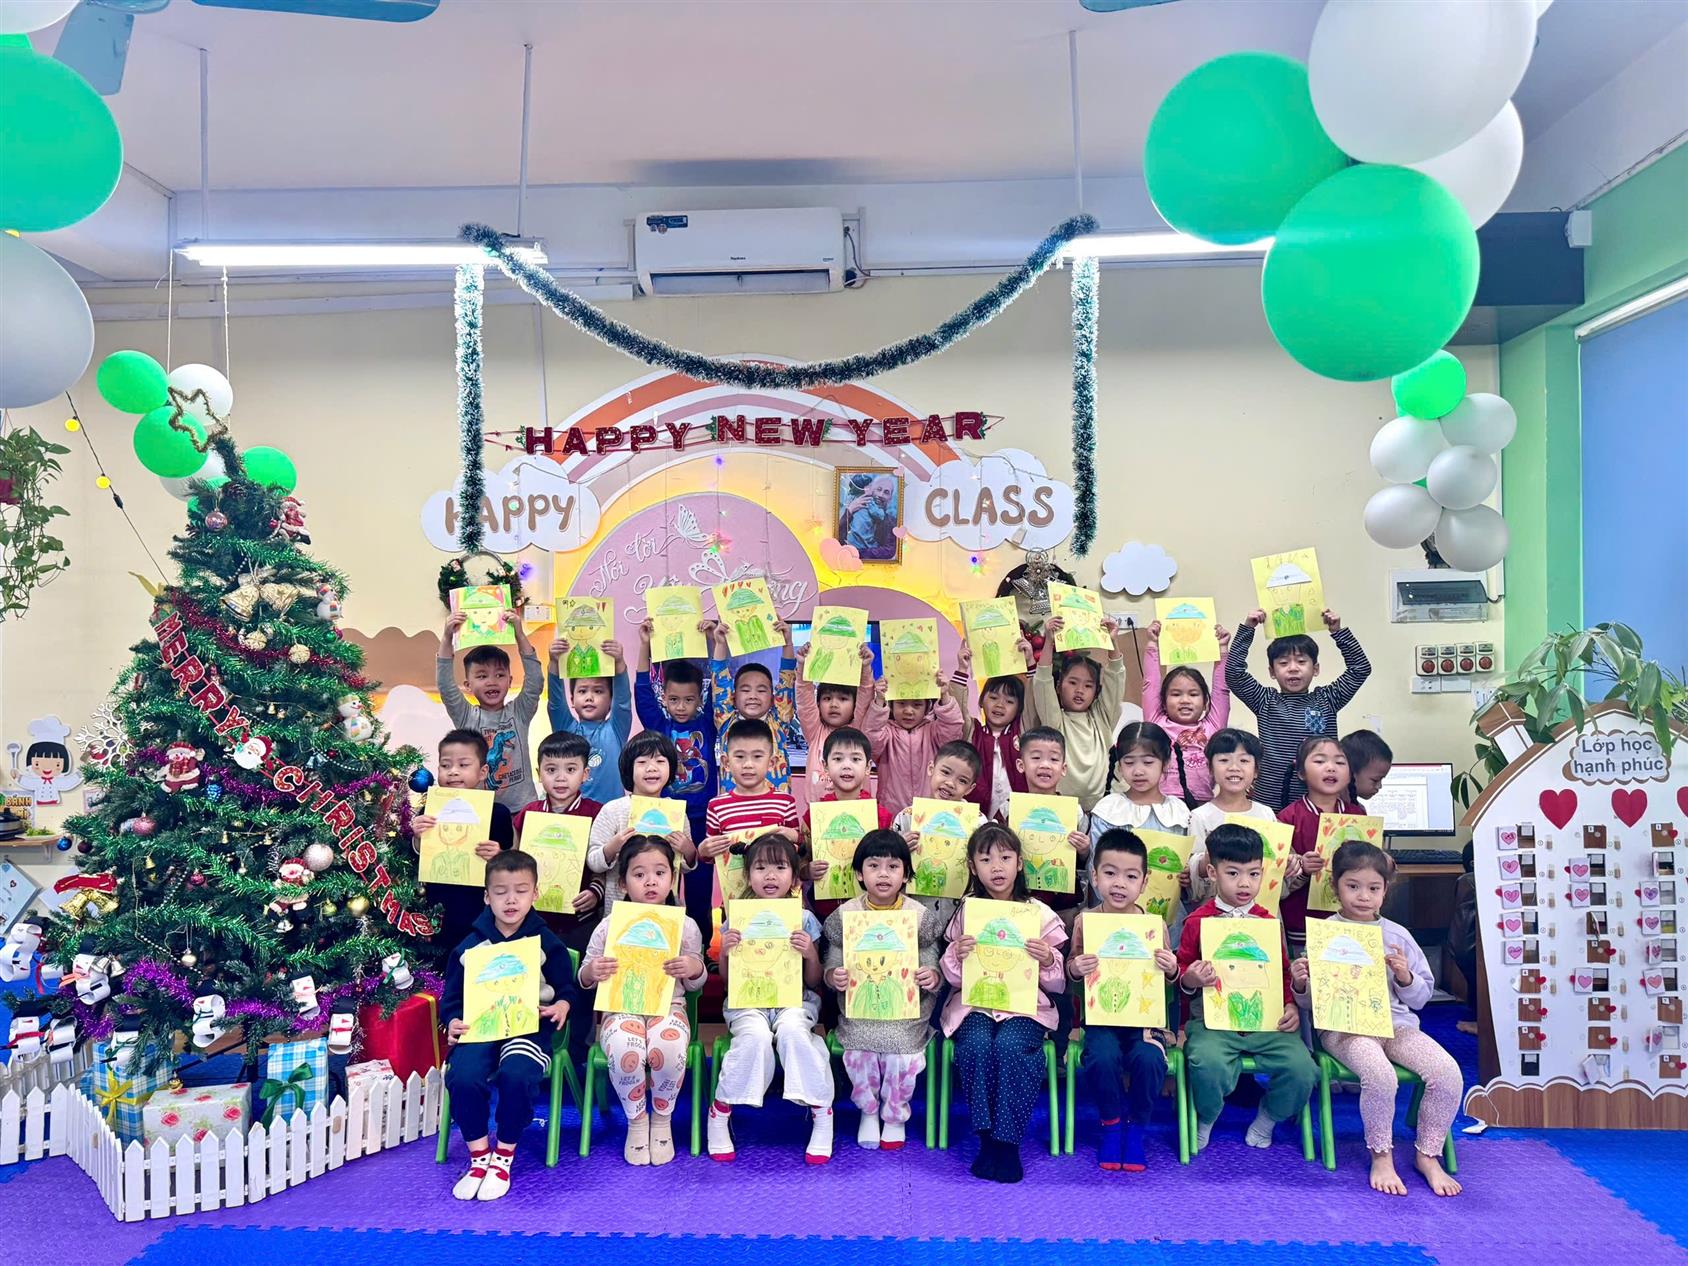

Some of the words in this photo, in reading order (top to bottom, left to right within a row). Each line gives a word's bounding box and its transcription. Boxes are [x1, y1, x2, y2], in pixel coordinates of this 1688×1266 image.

[525, 422, 692, 456] HAPPY
[716, 414, 826, 447] NEW
[847, 411, 985, 447] YEAR
[925, 485, 1055, 528] CLASS
[153, 611, 251, 736] MERRY
[1574, 758, 1616, 776] hạnh
[1622, 757, 1664, 775] phúc
[1582, 738, 1616, 755] Lớp
[1621, 738, 1653, 755] học
[273, 765, 435, 937] CHRISTMAS
